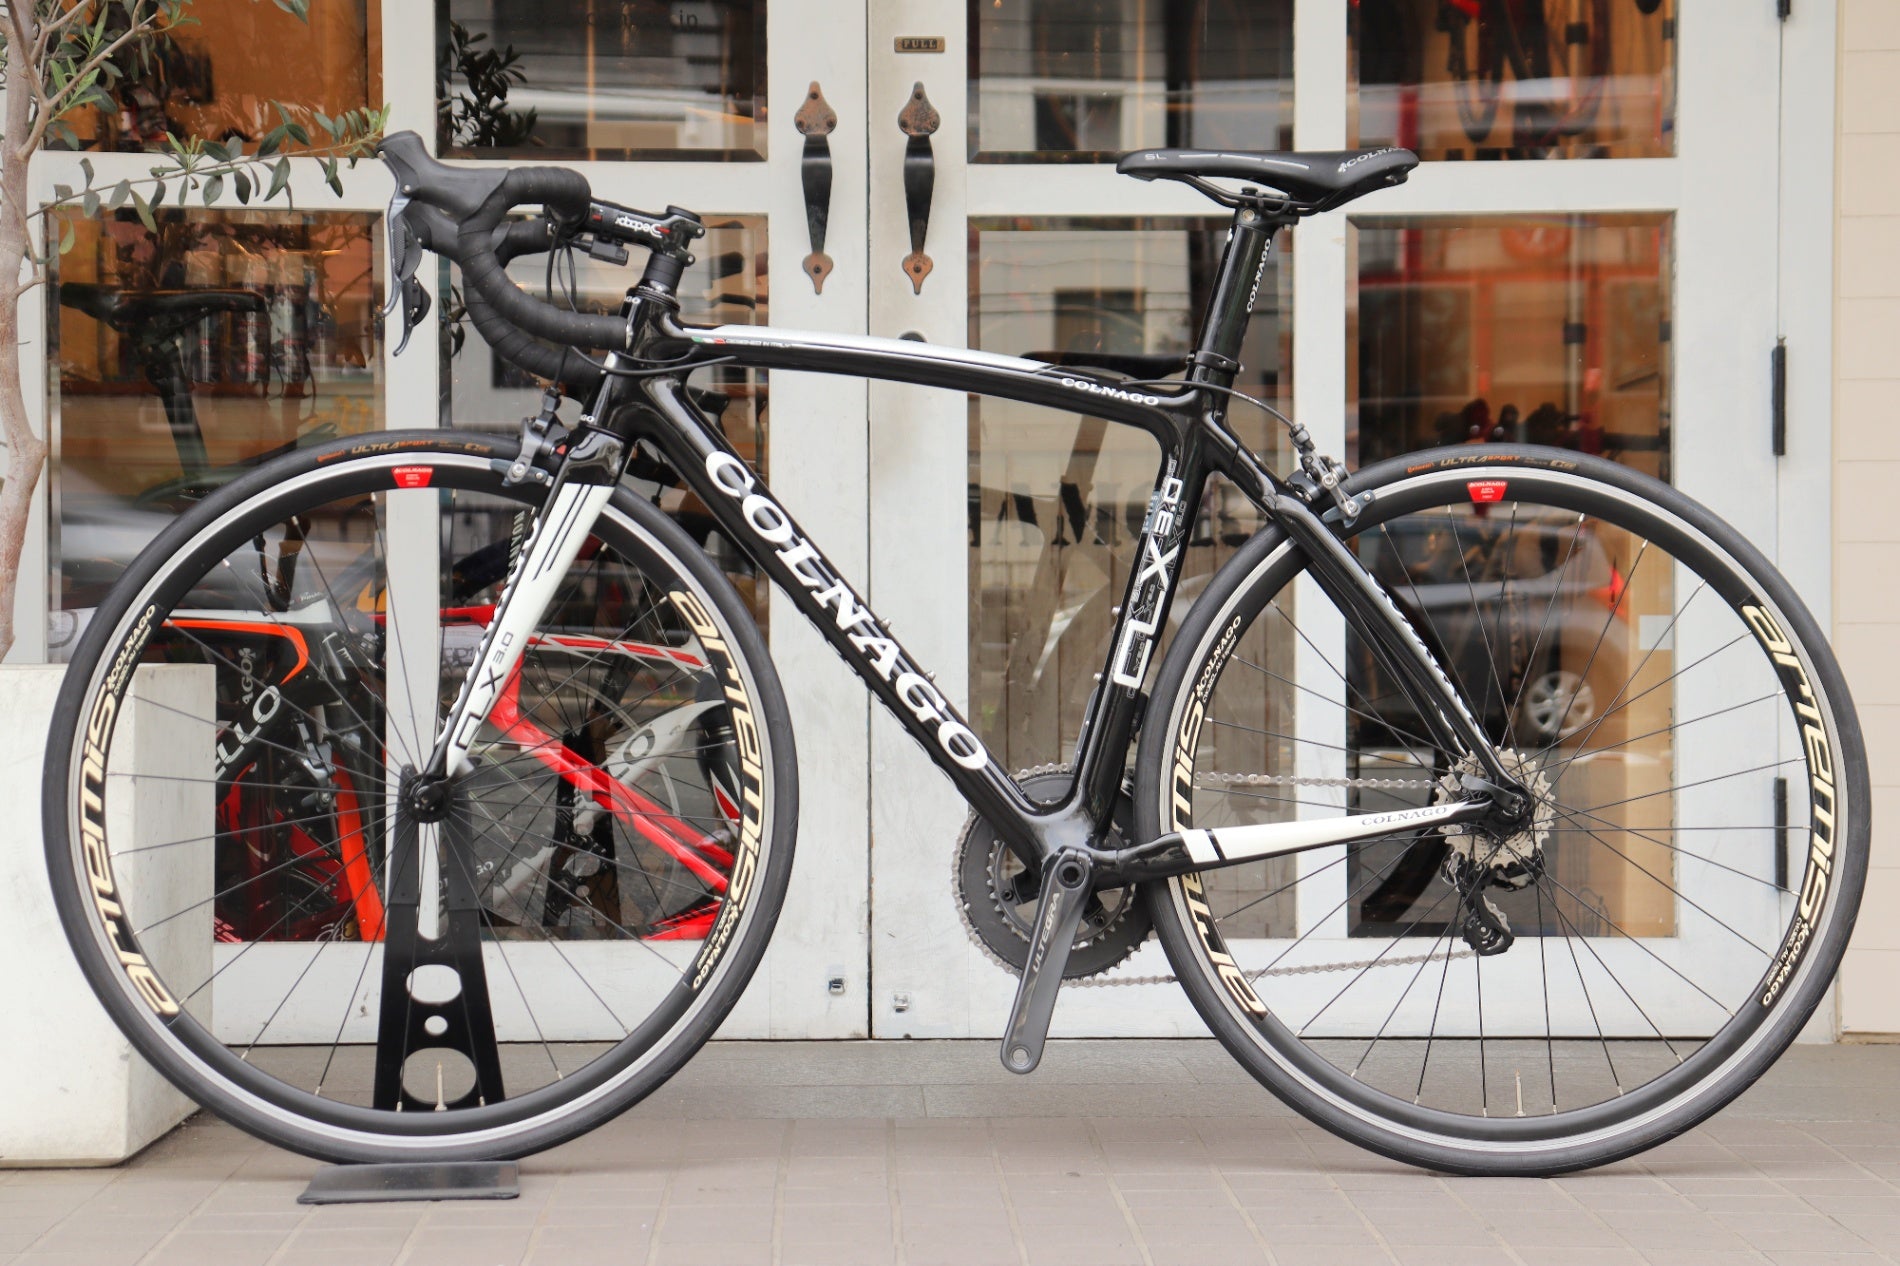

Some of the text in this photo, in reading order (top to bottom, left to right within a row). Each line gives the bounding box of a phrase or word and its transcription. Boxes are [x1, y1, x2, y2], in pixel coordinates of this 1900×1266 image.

[1144, 153, 1167, 161] SL
[1246, 238, 1271, 313] COLNAGO
[1060, 377, 1160, 407] COLNAGO
[351, 441, 401, 455] ULTRA
[399, 439, 434, 449] SPORT
[1440, 455, 1489, 467] ULTRA
[1487, 454, 1521, 462] SPORT
[110, 604, 156, 682] COLNAGO
[706, 450, 989, 771] COLNAGO
[1112, 533, 1180, 690] CLX
[1200, 614, 1242, 687] COLNAGO
[1361, 806, 1448, 827] COLNAGO
[692, 912, 736, 990] COLNAGO
[1032, 892, 1060, 973] ULTEGRA
[1761, 930, 1805, 1007] COLNAGO
